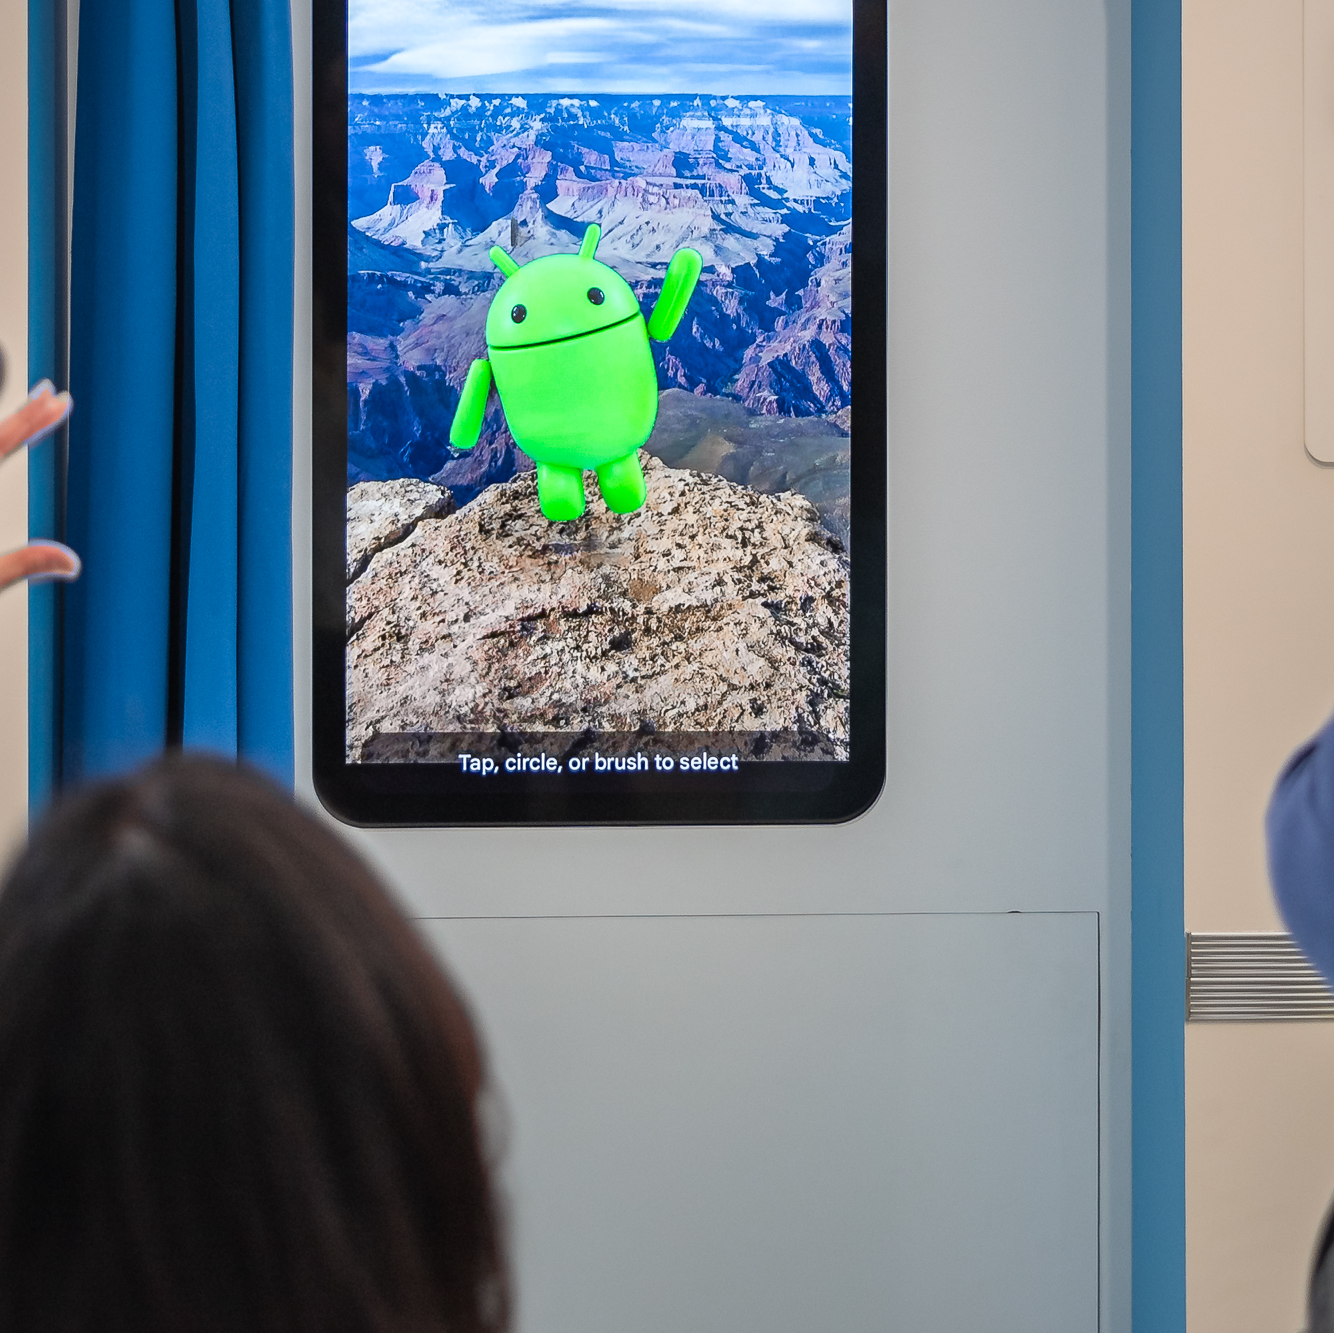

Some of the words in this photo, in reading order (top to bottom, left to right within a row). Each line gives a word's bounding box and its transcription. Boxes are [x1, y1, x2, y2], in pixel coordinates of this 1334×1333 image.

[458, 753, 499, 775] Tap,
[505, 752, 563, 774] circle,
[568, 756, 590, 772] or
[594, 751, 649, 772] brush
[654, 753, 675, 771] to
[679, 751, 739, 771] select
